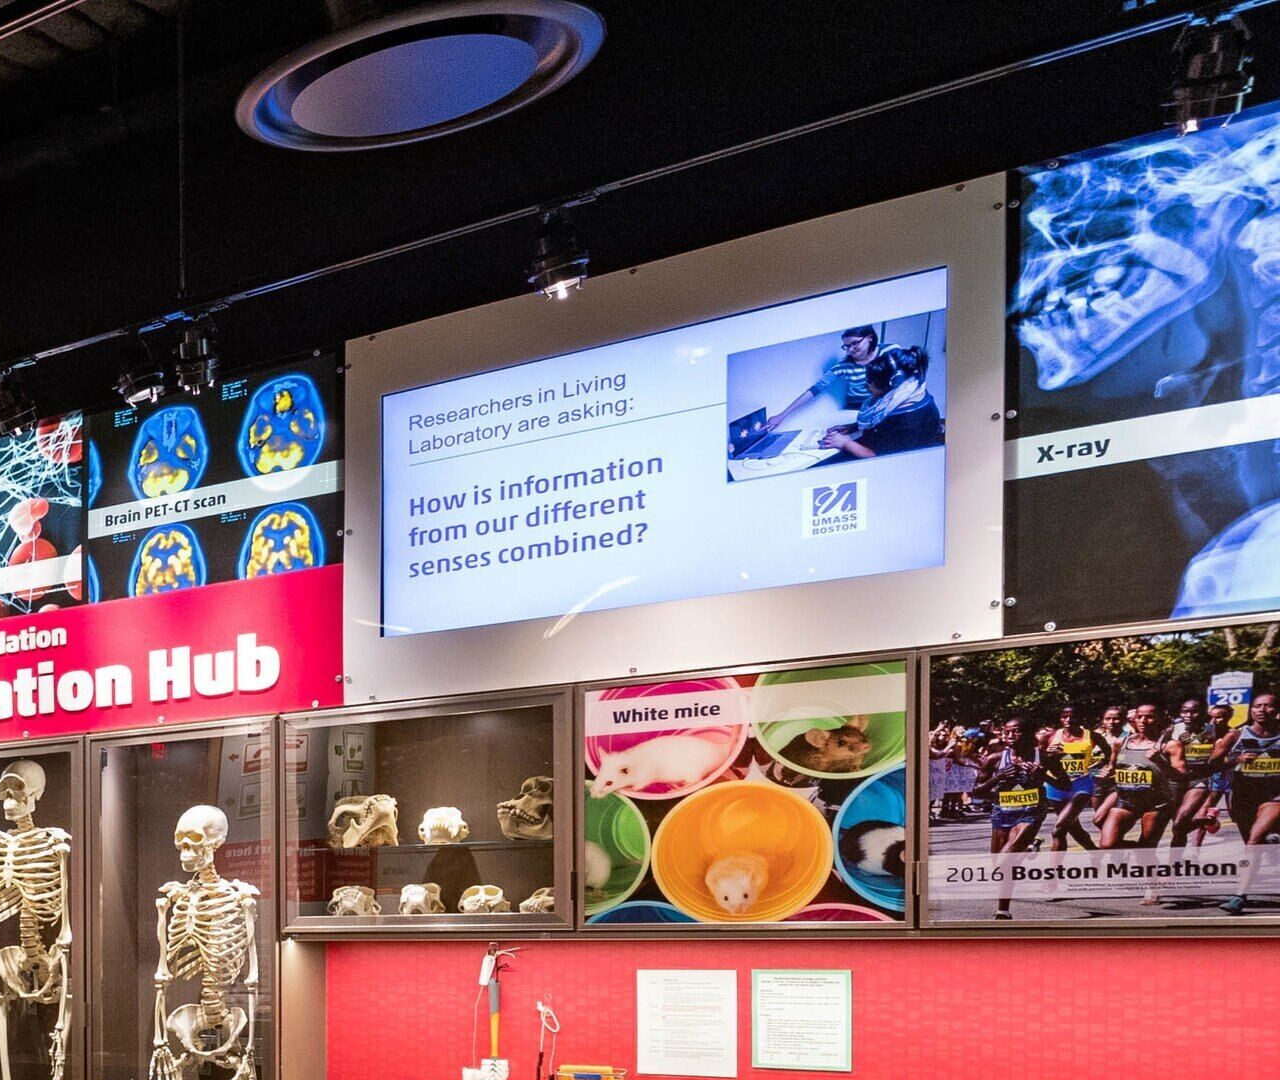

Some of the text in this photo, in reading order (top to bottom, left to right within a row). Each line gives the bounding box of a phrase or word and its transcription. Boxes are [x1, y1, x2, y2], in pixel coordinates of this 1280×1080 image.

[408, 373, 627, 431] Researchers in Living
[408, 397, 634, 455] Laboratory are asking:
[1037, 437, 1111, 465] X-ray
[409, 456, 663, 517] How is information
[103, 494, 226, 527] Brain PET-CT scan
[408, 490, 646, 547] from our different
[812, 513, 857, 527] UMASS
[812, 522, 857, 536] BOSTON
[408, 522, 648, 578] senses combined?
[148, 632, 281, 703] Hub
[613, 703, 721, 725] White mice
[1117, 770, 1148, 784] DEBA
[946, 866, 1004, 883] 2016
[1011, 864, 1098, 881] Boston
